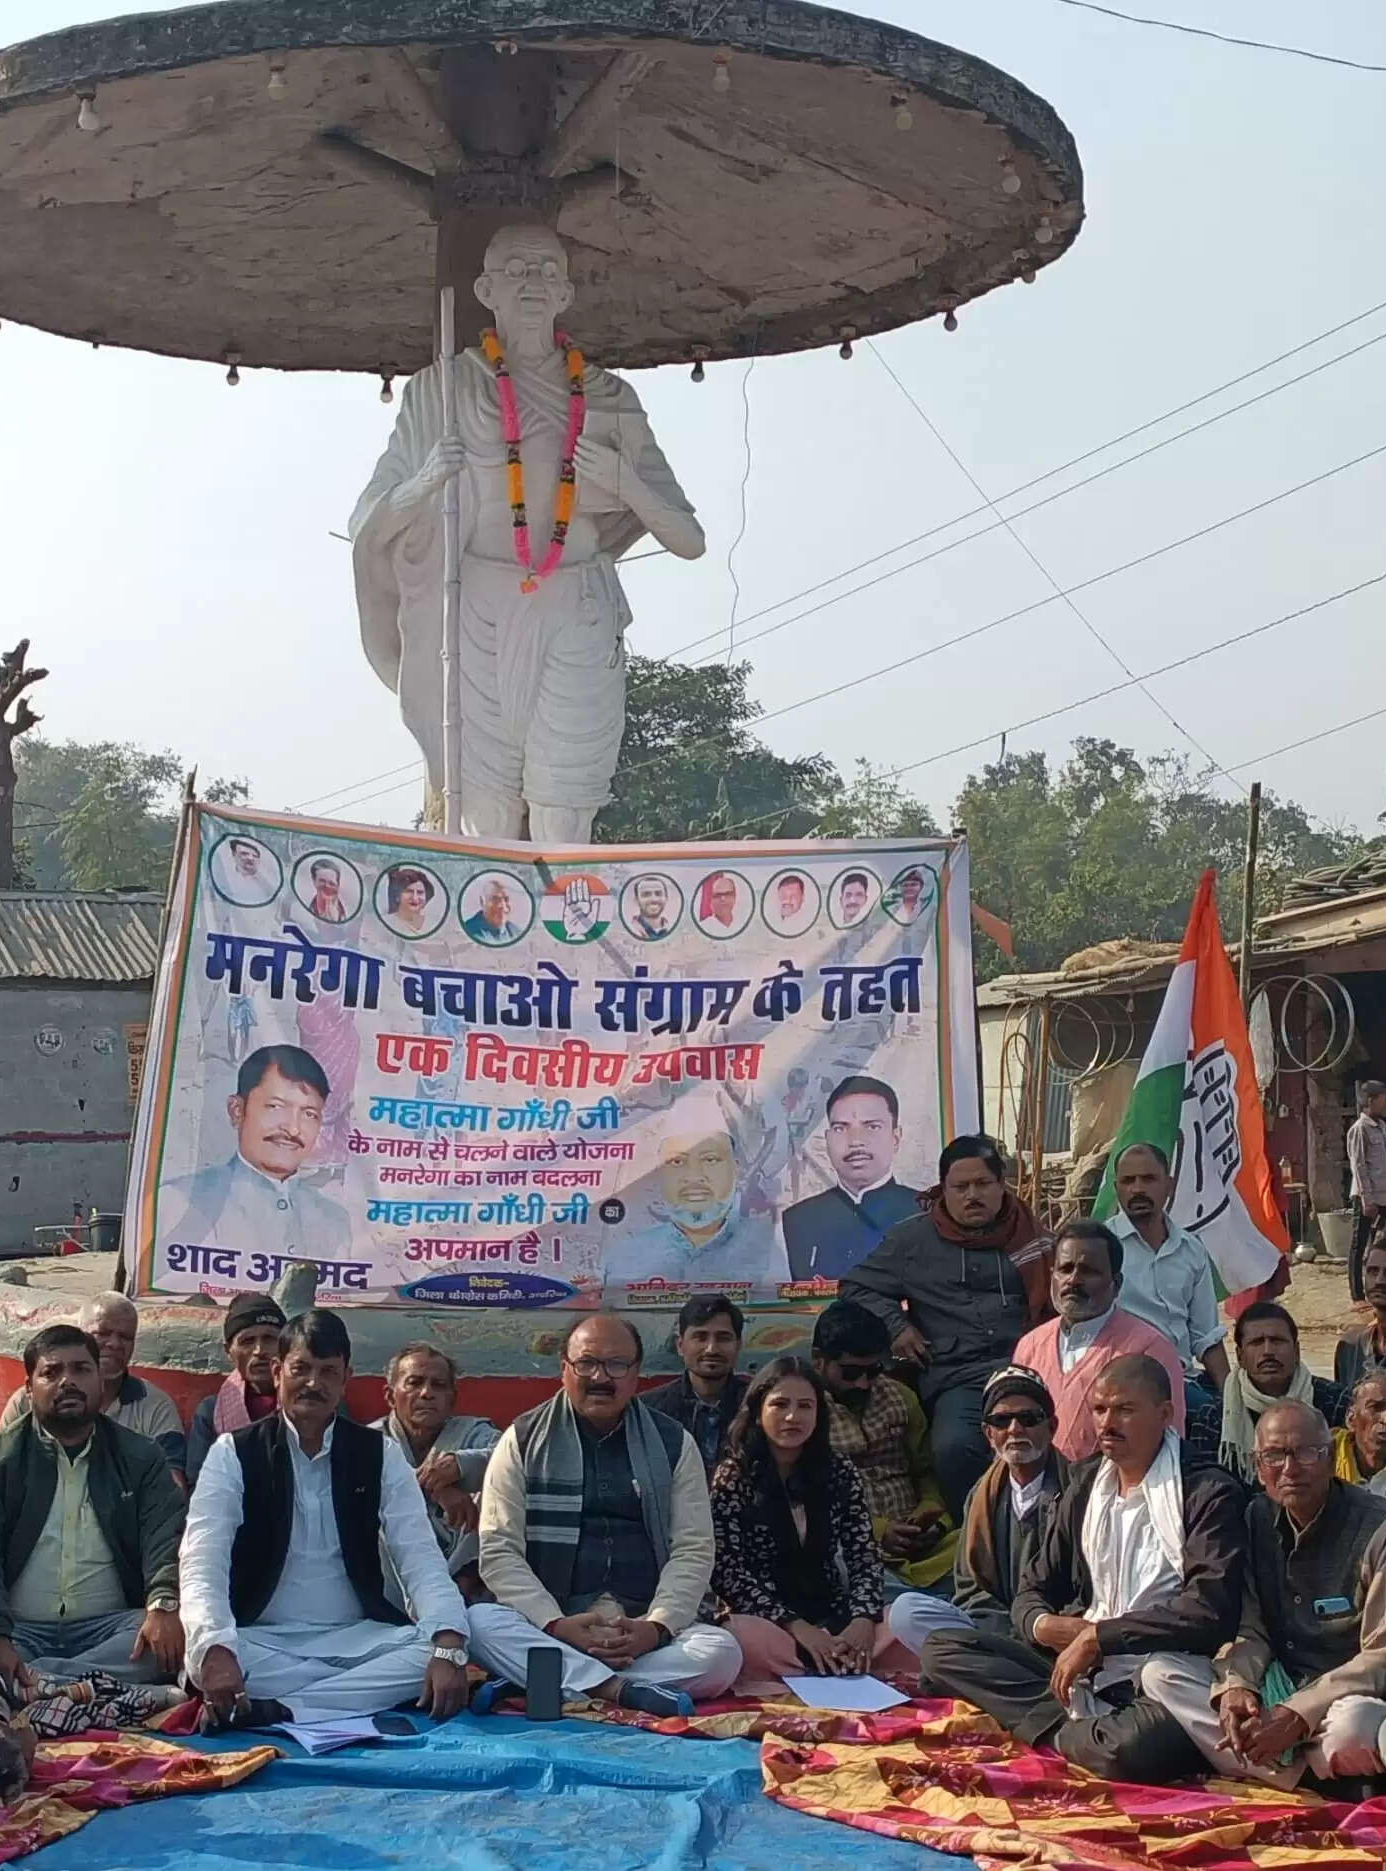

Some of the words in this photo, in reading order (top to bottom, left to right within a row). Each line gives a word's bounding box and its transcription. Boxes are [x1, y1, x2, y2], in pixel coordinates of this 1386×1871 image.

[206, 925, 385, 1010] मनरेगा
[399, 961, 578, 1030] बचाओ
[594, 965, 750, 1036] संग्राम
[753, 959, 804, 1021] के
[820, 957, 924, 1022] तहत
[375, 1033, 453, 1077] एक
[465, 1033, 628, 1089] दिवसीय
[631, 1043, 765, 1086] उपवास
[369, 1096, 489, 1131] महात्मा
[497, 1098, 569, 1132] गाँधी
[577, 1096, 621, 1131] जी
[348, 1129, 372, 1155] के
[376, 1138, 421, 1160] नाम
[428, 1135, 449, 1161] से
[454, 1139, 509, 1163] चलने
[513, 1137, 557, 1161] वाले
[562, 1139, 635, 1161] योजना
[379, 1165, 450, 1187] मनरेगा
[454, 1170, 481, 1187] का
[486, 1170, 526, 1187] नाम
[533, 1169, 602, 1187] बदलना
[367, 1199, 470, 1227] महात्मा
[477, 1192, 545, 1227] गाँधी
[552, 1192, 589, 1226] जी
[405, 1238, 512, 1262] अपमान
[518, 1231, 541, 1264] है
[167, 1243, 241, 1279] शाद
[246, 1253, 373, 1289] अमद
